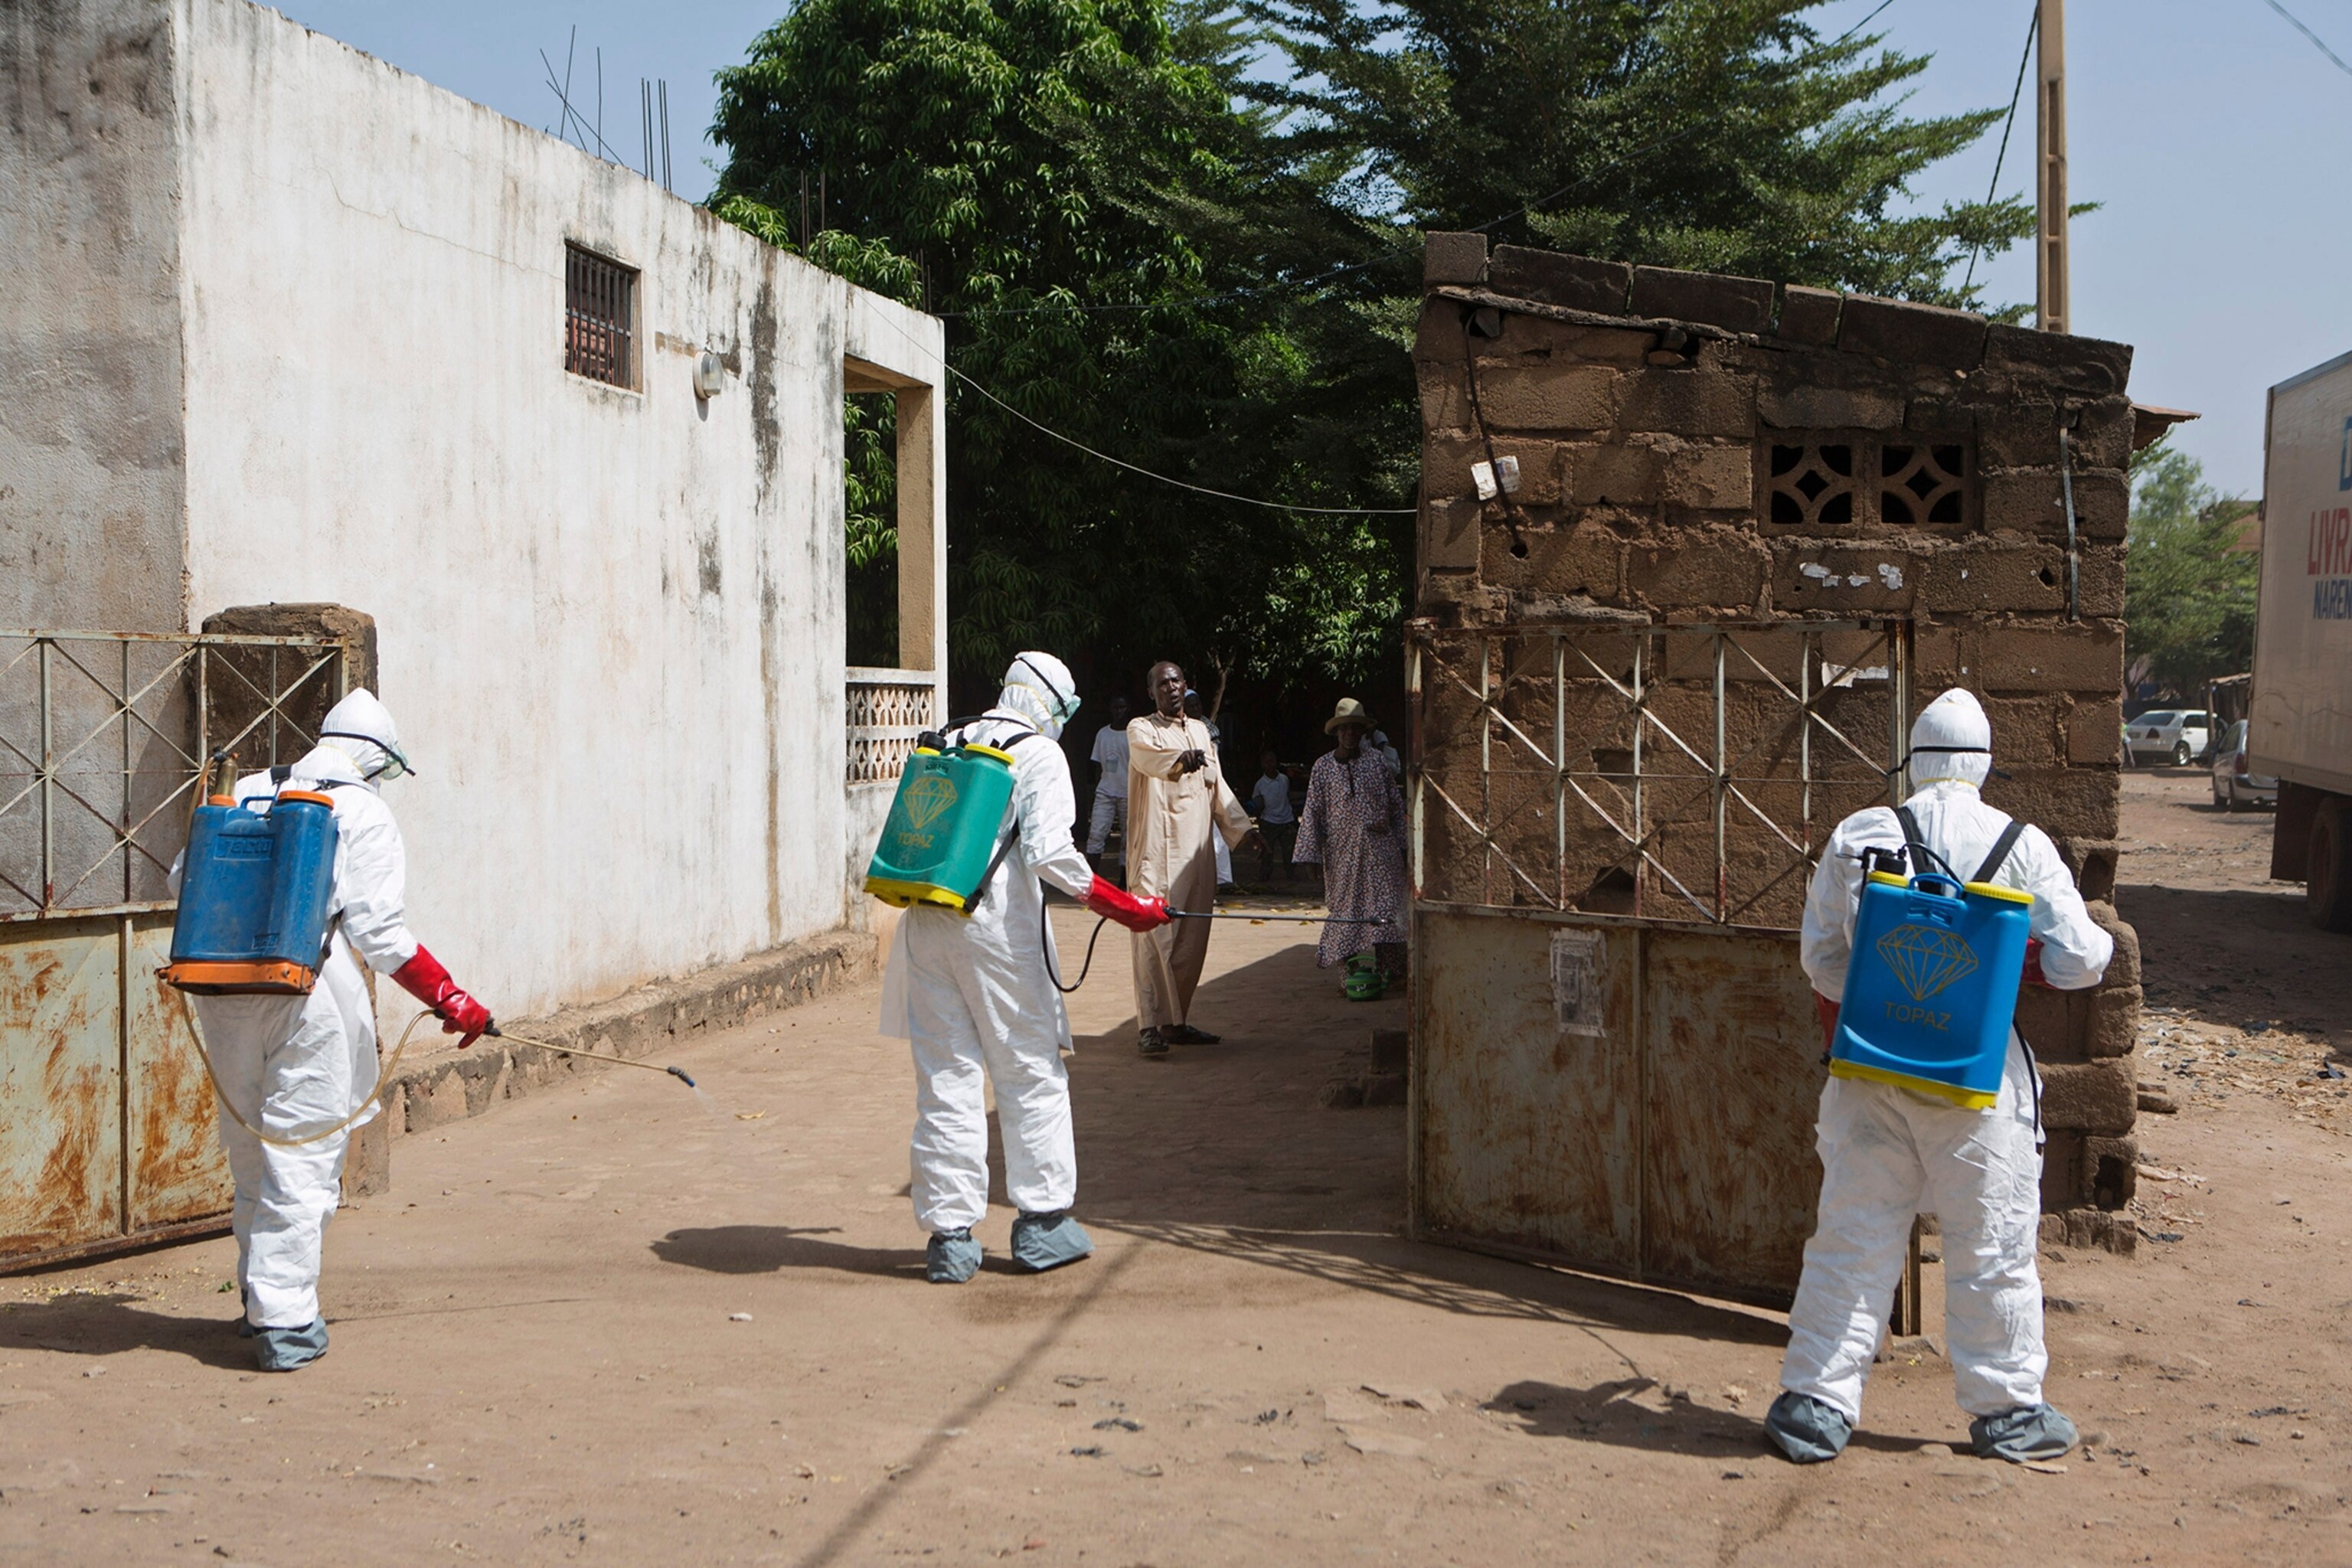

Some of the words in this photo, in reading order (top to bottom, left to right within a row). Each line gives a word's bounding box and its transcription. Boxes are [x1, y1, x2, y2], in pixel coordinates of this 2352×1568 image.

[2308, 507, 2352, 575] LIVR
[897, 831, 935, 849] TOPAZ
[1883, 1001, 1951, 1031] TOPAZ
